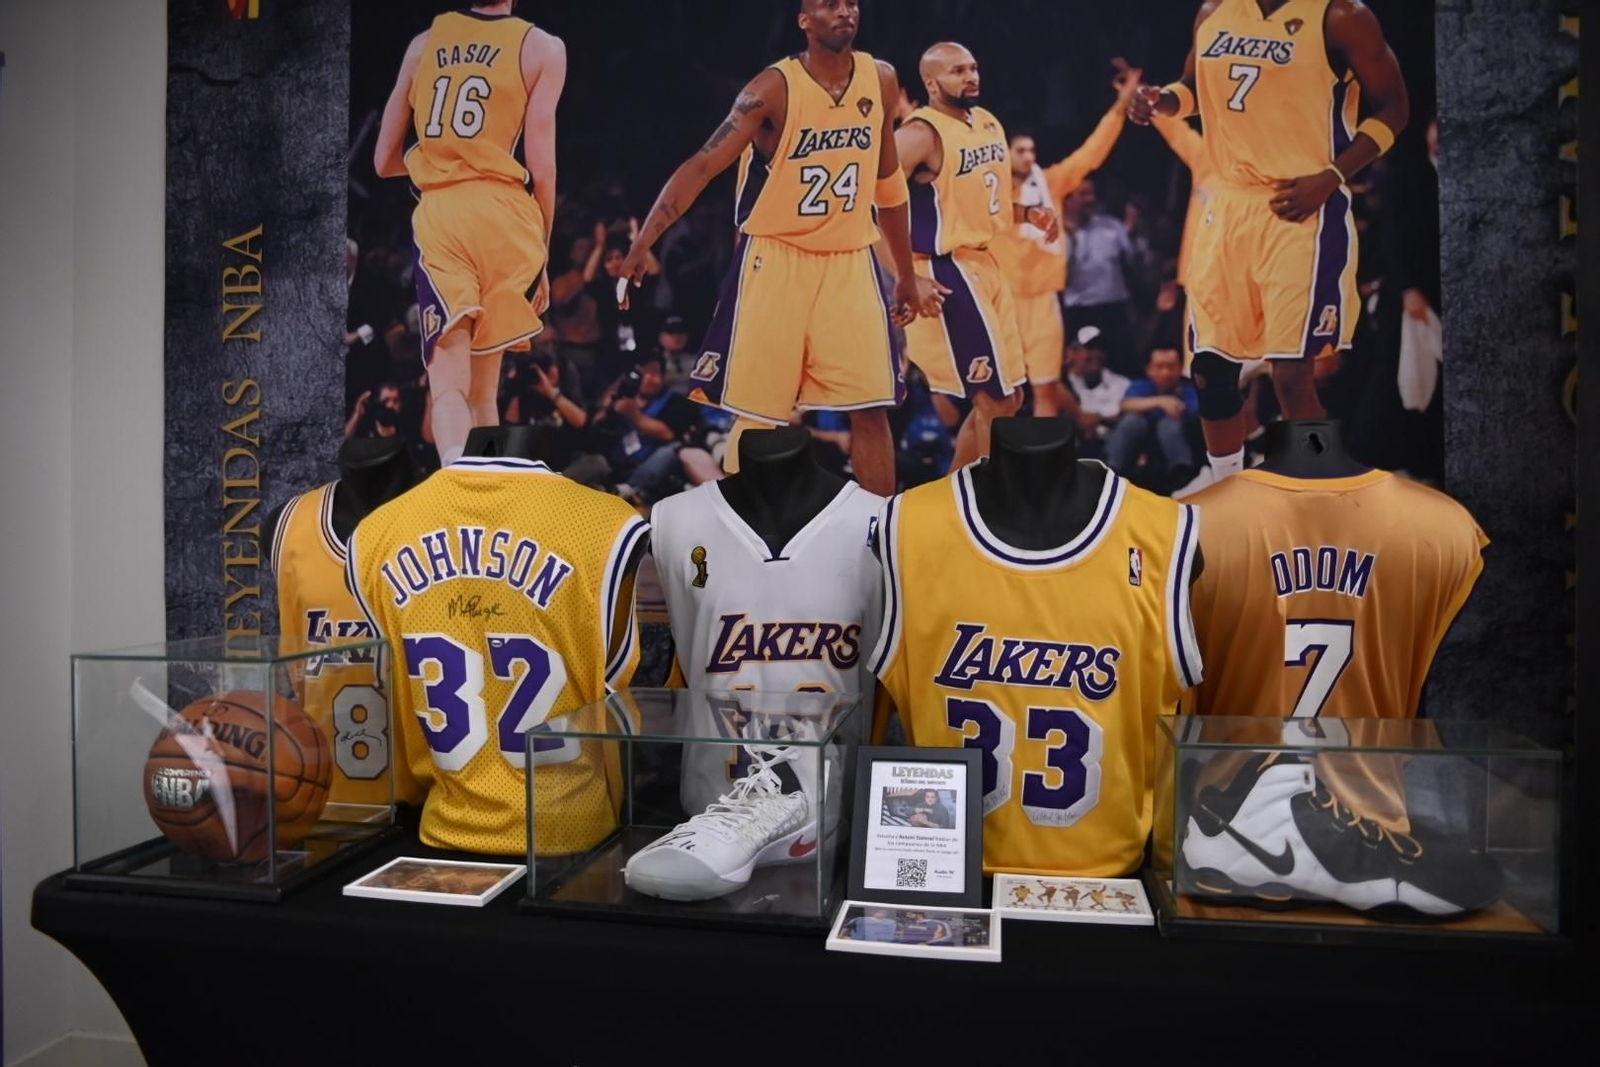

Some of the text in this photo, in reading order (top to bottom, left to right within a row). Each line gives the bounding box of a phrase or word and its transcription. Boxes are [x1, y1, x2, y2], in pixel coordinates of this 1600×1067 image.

[436, 43, 501, 69] GASOL
[1200, 30, 1295, 65] LAKERS
[424, 75, 492, 139] 16
[1226, 63, 1261, 112] 7
[787, 126, 872, 160] LAKERS
[798, 162, 859, 216] 24
[222, 223, 263, 648] EYENDAS NBA
[380, 526, 574, 609] JOHNSON
[1270, 546, 1376, 599] ODOM
[705, 613, 862, 671] LAKERS
[933, 622, 1121, 701] LAKERS
[1284, 618, 1355, 719] 7
[332, 684, 390, 780] 8
[400, 632, 583, 771] 32
[892, 766, 954, 780] LEYENDAS
[946, 696, 1104, 828] 33
